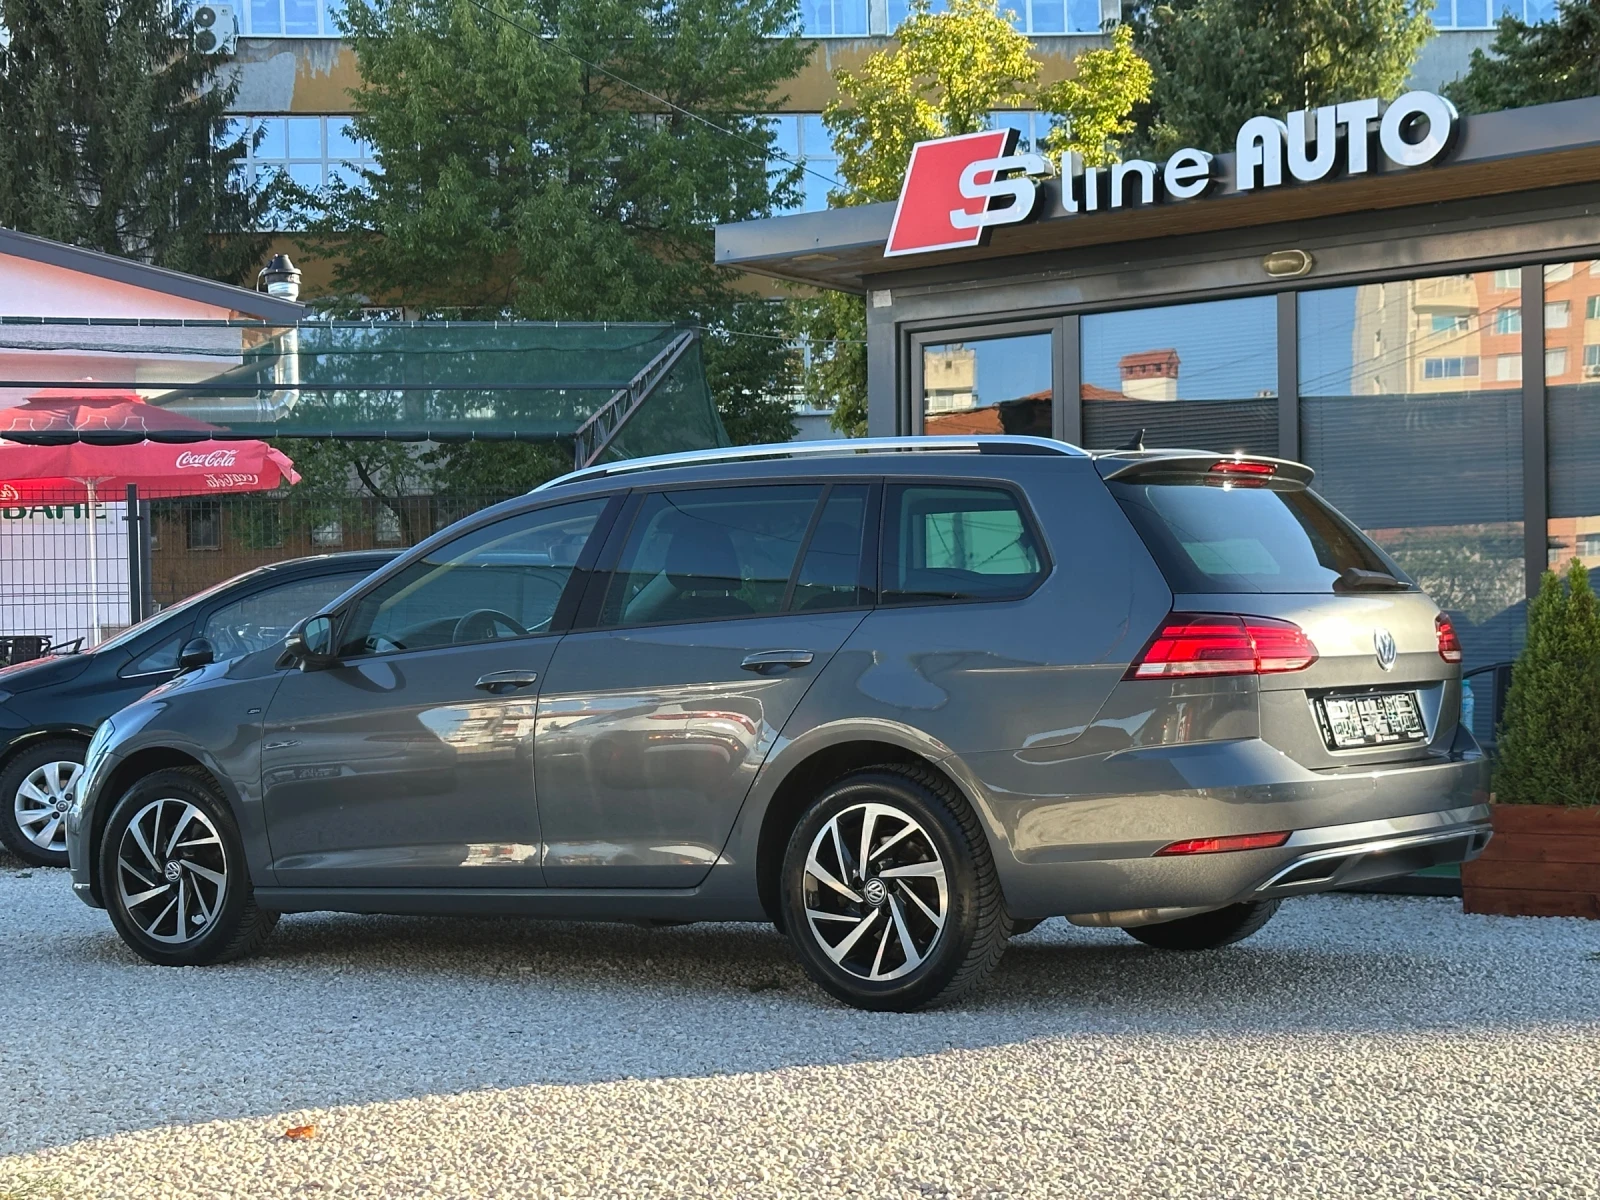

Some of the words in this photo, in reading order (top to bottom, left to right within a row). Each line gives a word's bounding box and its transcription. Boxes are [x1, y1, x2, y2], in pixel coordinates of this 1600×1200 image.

[949, 153, 1045, 230] S
[1061, 148, 1210, 213] line
[1236, 90, 1452, 191] AUTO
[175, 449, 240, 469] Coca-Cola
